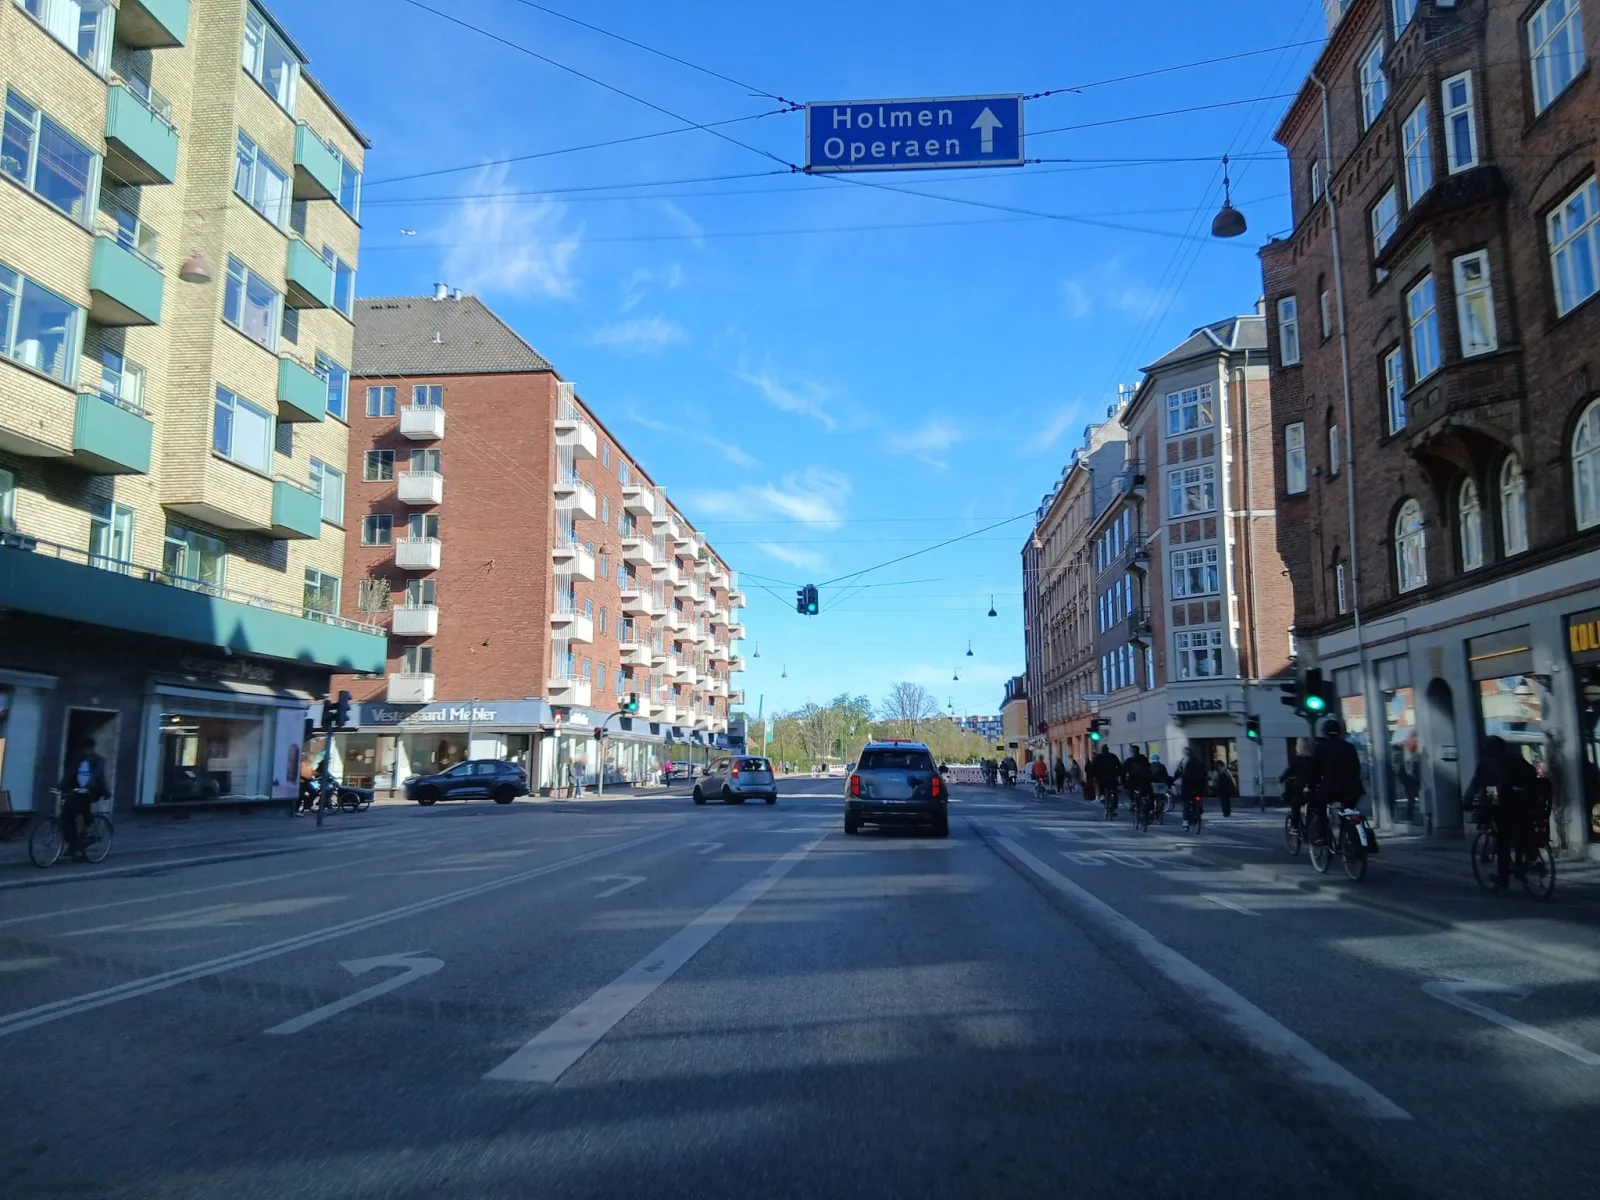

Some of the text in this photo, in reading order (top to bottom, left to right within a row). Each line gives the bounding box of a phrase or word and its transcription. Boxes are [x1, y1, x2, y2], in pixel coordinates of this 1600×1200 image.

[833, 106, 953, 129] Holmen
[823, 137, 960, 162] Operaen
[1570, 620, 1600, 652] KOL
[1177, 698, 1222, 711] matas
